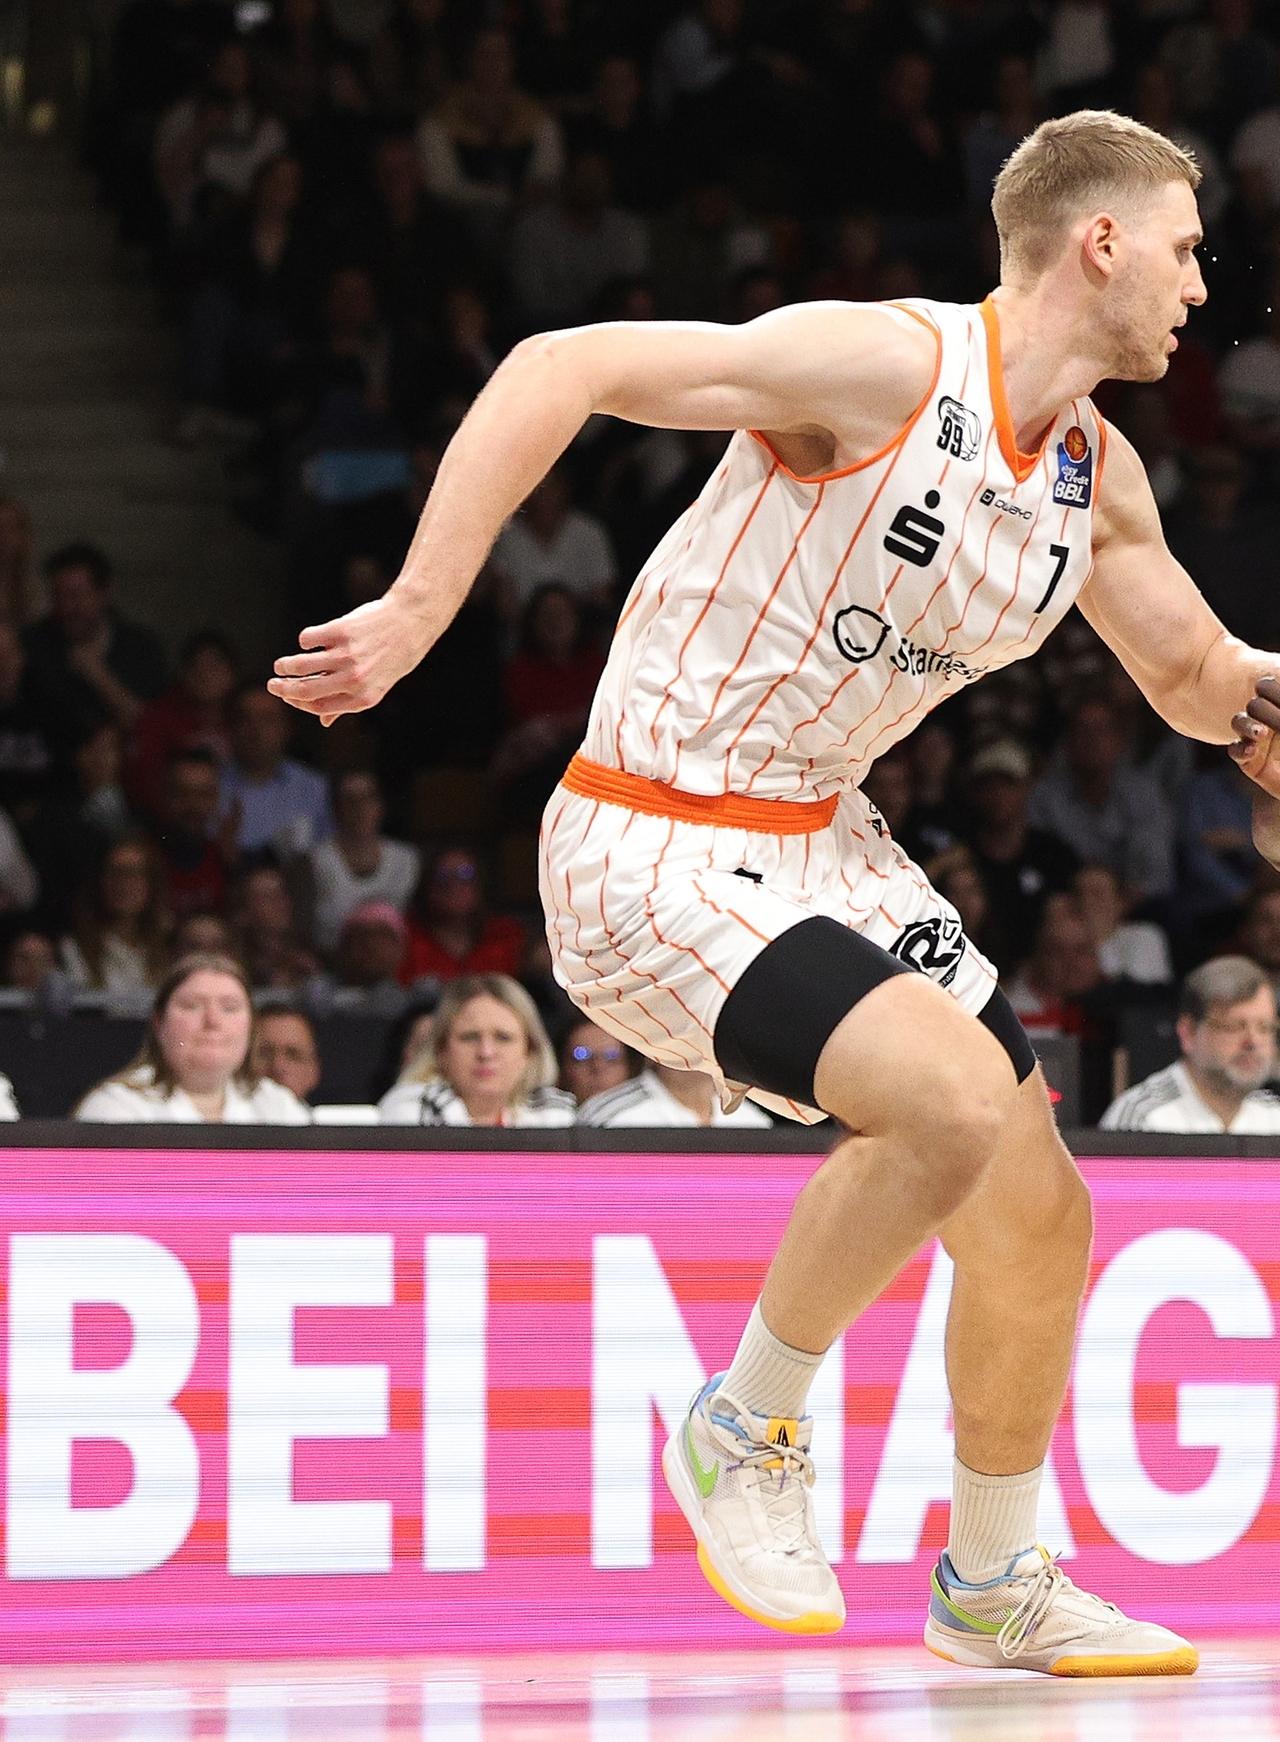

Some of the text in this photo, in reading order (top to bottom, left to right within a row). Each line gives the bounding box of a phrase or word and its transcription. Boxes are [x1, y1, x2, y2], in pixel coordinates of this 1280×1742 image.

[936, 415, 963, 458] 99
[1054, 480, 1085, 503] BBL
[5, 1232, 488, 1581] BEI
